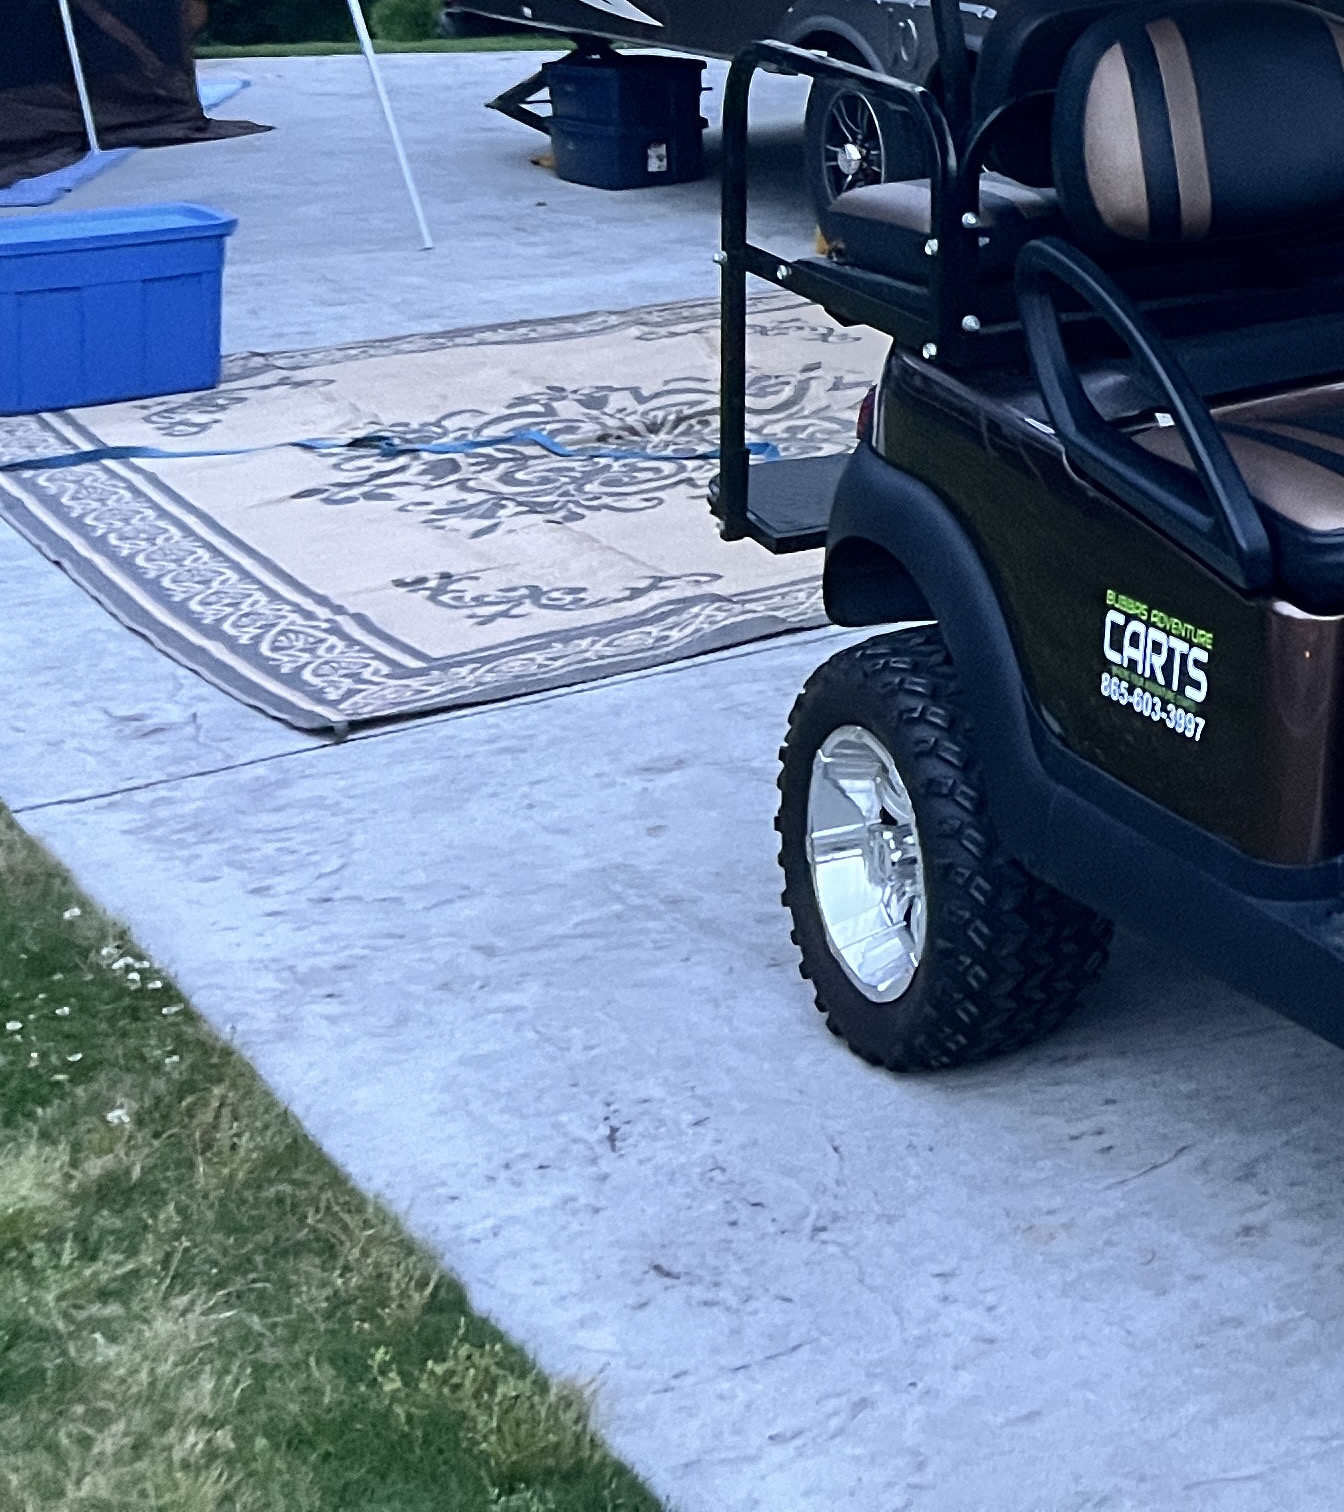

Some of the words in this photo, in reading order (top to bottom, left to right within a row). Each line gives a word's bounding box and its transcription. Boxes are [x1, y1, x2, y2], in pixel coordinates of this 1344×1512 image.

[1103, 609, 1209, 703] CARTS
[1150, 609, 1213, 649] ADVENTURE
[1100, 672, 1206, 742] 865-603-3997
